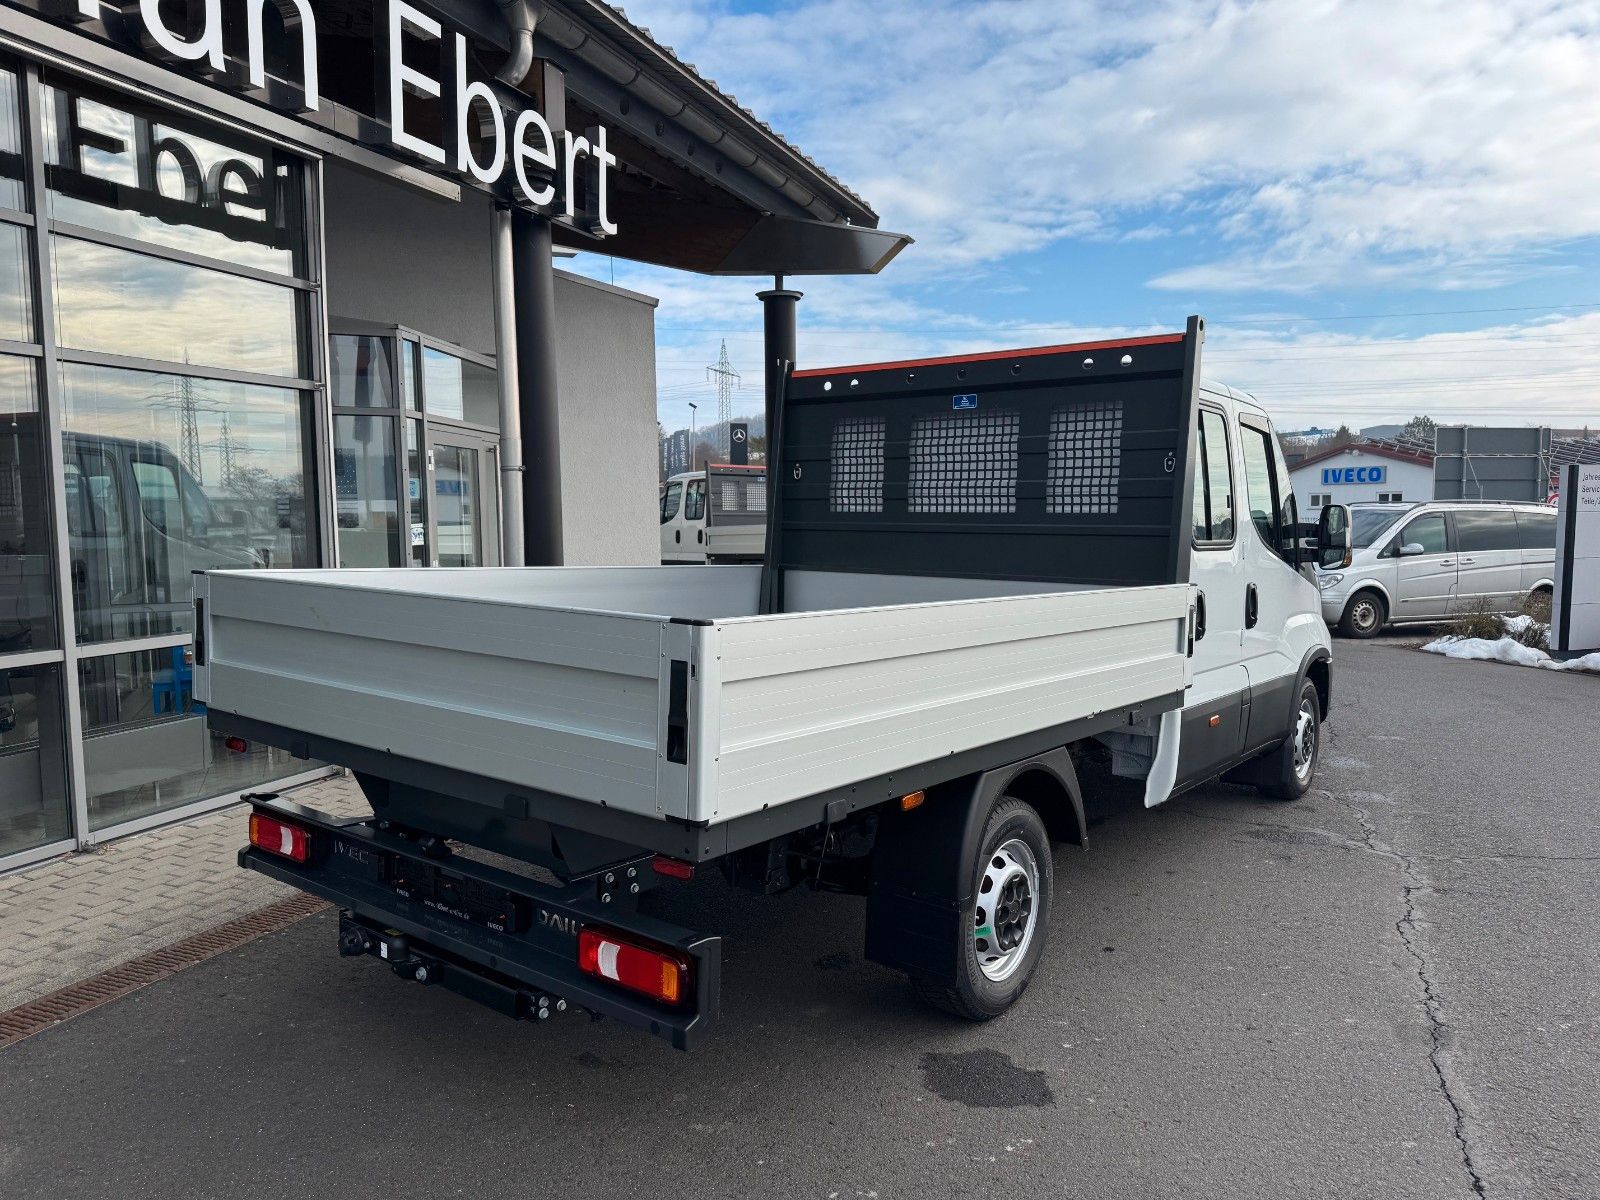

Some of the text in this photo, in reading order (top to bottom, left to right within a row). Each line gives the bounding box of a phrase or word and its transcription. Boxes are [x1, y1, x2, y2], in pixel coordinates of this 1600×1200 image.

[389, 0, 618, 235] Ebert
[1323, 467, 1382, 483] IVECO
[536, 908, 585, 936] DAIL
